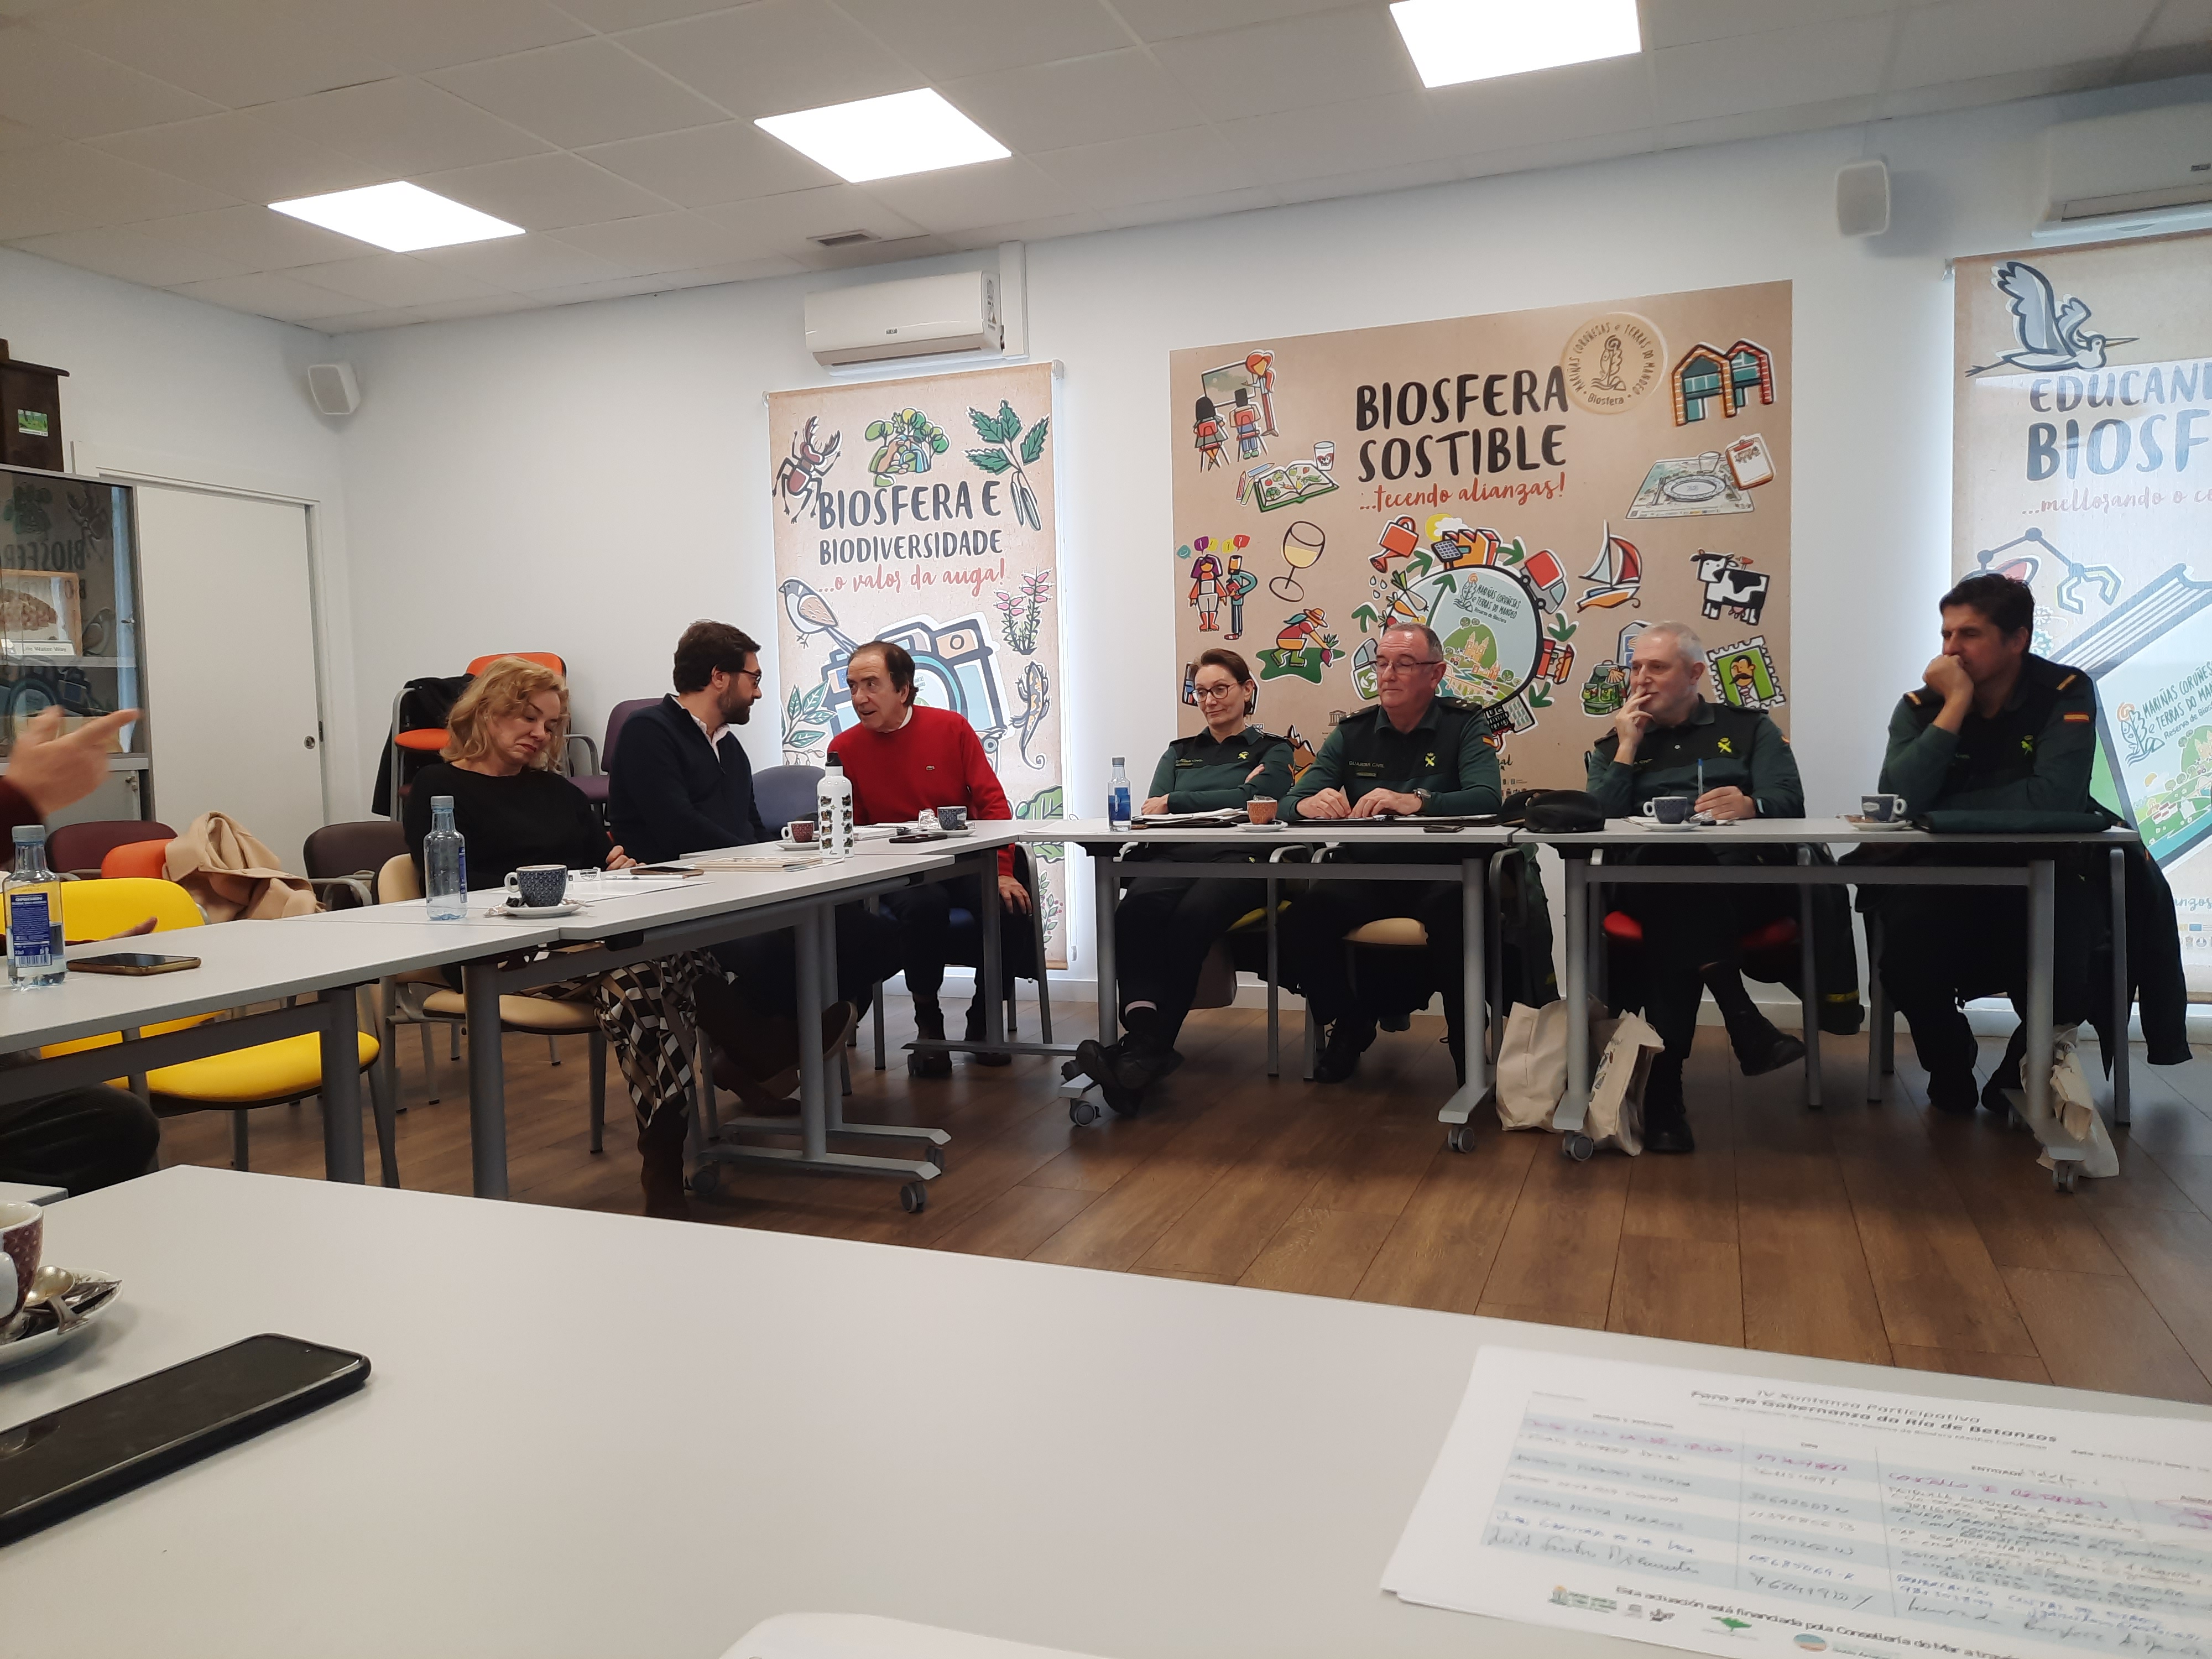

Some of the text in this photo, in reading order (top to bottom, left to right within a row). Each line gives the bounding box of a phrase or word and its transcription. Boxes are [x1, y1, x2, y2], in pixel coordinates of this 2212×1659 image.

[1356, 365, 1569, 431] BIOSFERA
[1358, 424, 1568, 483] SOSTIBLE
[2026, 409, 2211, 481] BIOSF
[818, 481, 1001, 530] BIOSFERA E
[1458, 471, 1566, 506] alianzas!
[820, 529, 1003, 565] BIODIVERSIDADE
[853, 563, 901, 594] valor
[910, 564, 937, 589] da
[942, 557, 1005, 597] auga!
[2142, 685, 2178, 719] MARIÑAS
[2156, 702, 2184, 731] TERRAS
[2185, 696, 2197, 711] DO
[2163, 720, 2189, 739] Reserva
[2190, 713, 2198, 722] de
